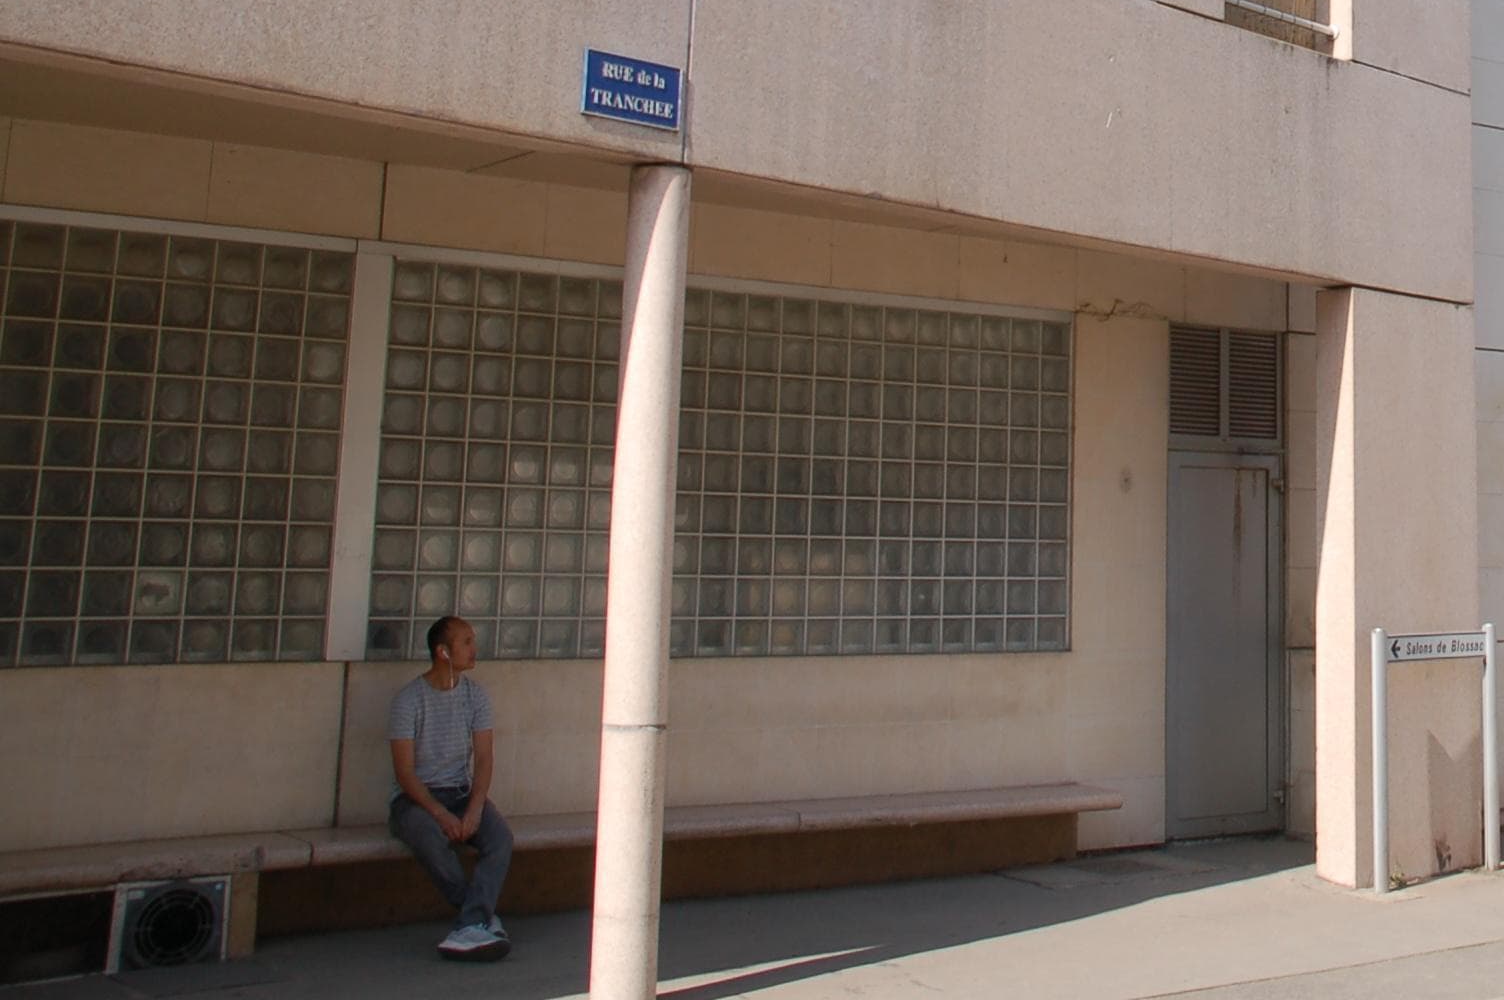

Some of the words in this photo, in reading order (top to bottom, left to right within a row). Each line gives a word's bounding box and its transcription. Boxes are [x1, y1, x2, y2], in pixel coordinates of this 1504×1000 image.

[602, 61, 633, 82] RUE
[638, 69, 652, 86] de
[653, 72, 666, 89] la
[591, 87, 674, 119] TRANCHEE
[1406, 641, 1433, 656] Salons
[1436, 640, 1447, 654] de
[1451, 639, 1484, 653] Blossac
